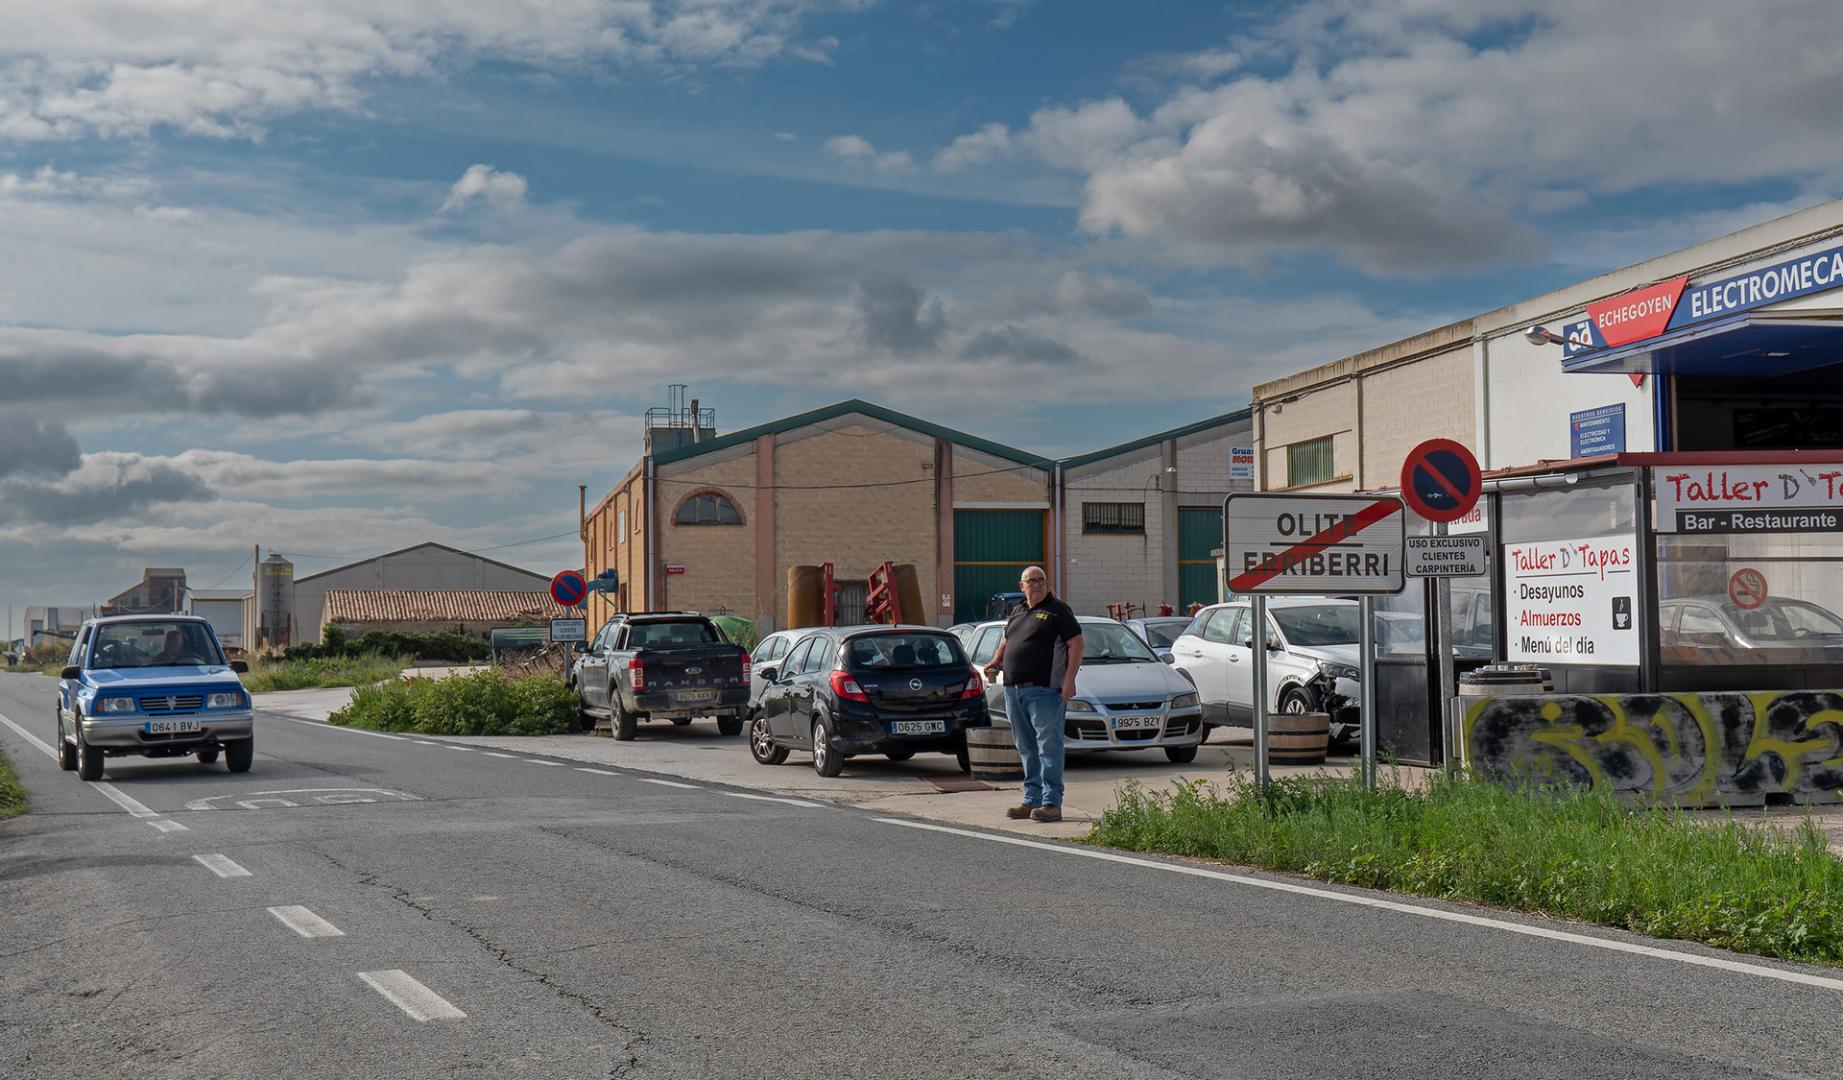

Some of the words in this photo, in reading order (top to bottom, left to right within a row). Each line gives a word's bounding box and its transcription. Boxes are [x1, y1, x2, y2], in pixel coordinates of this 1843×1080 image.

[1691, 252, 1843, 318] ELECTROMECA
[1598, 294, 1672, 329] ECHEGOYEN
[1666, 471, 1769, 502] Taller
[1818, 471, 1843, 500] T
[1277, 513, 1357, 537] OLITE
[1685, 514, 1715, 530] Bar
[1732, 512, 1837, 529] Restaurante
[1409, 540, 1428, 548] USO
[1430, 539, 1480, 548] EXCLUSIVO
[1244, 552, 1389, 577] ERRIBERRI
[1422, 551, 1466, 561] CLIENTES
[1512, 547, 1556, 572] Taller
[1578, 544, 1630, 581] Tapas
[1415, 562, 1476, 574] CARPINTERÍA
[1520, 583, 1584, 603] Desayunos
[1520, 609, 1582, 626] Almuerzos
[1521, 636, 1551, 653] Menú
[1555, 636, 1572, 653] del
[1576, 636, 1594, 654] día
[648, 677, 738, 687] RANGER
[181, 721, 199, 730] BVJ
[898, 723, 922, 731] 0625
[925, 722, 943, 731] GWC
[1117, 718, 1140, 727] 9975
[1144, 717, 1160, 726] BZY
